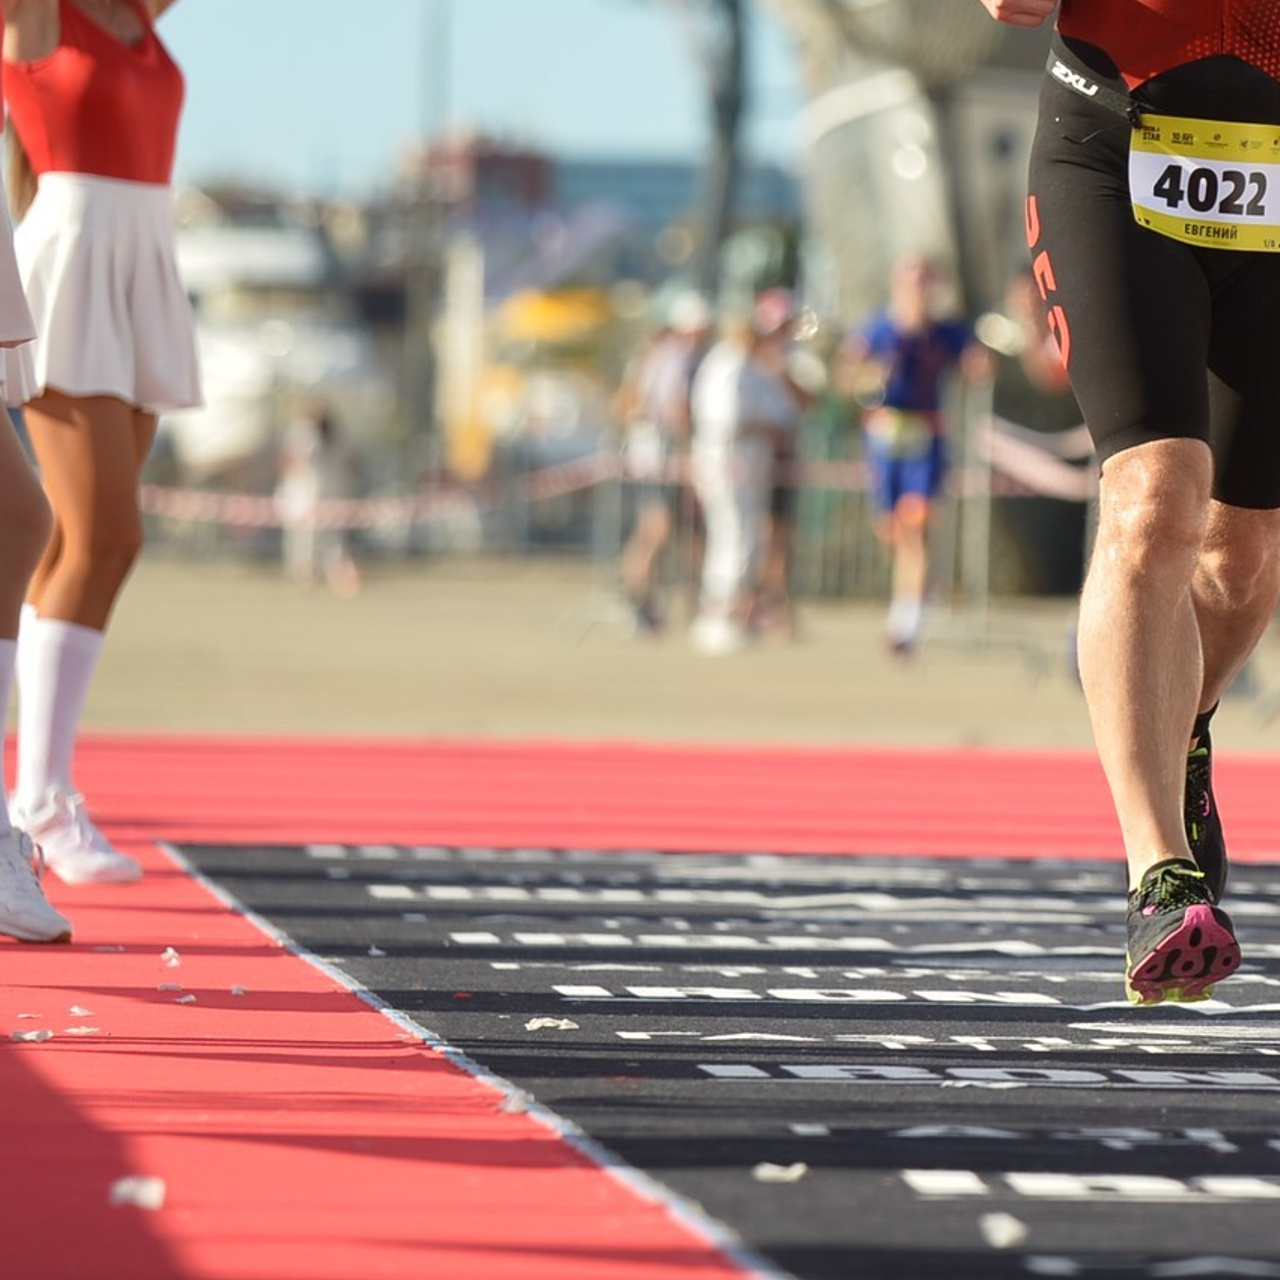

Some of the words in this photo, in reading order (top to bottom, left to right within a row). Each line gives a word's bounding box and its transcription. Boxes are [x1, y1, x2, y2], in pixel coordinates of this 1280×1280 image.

[1052, 60, 1099, 96] 2XU
[1153, 164, 1267, 216] 4022
[1184, 223, 1238, 240] ЕВГЕНИЙ
[551, 985, 1063, 1004] IRON
